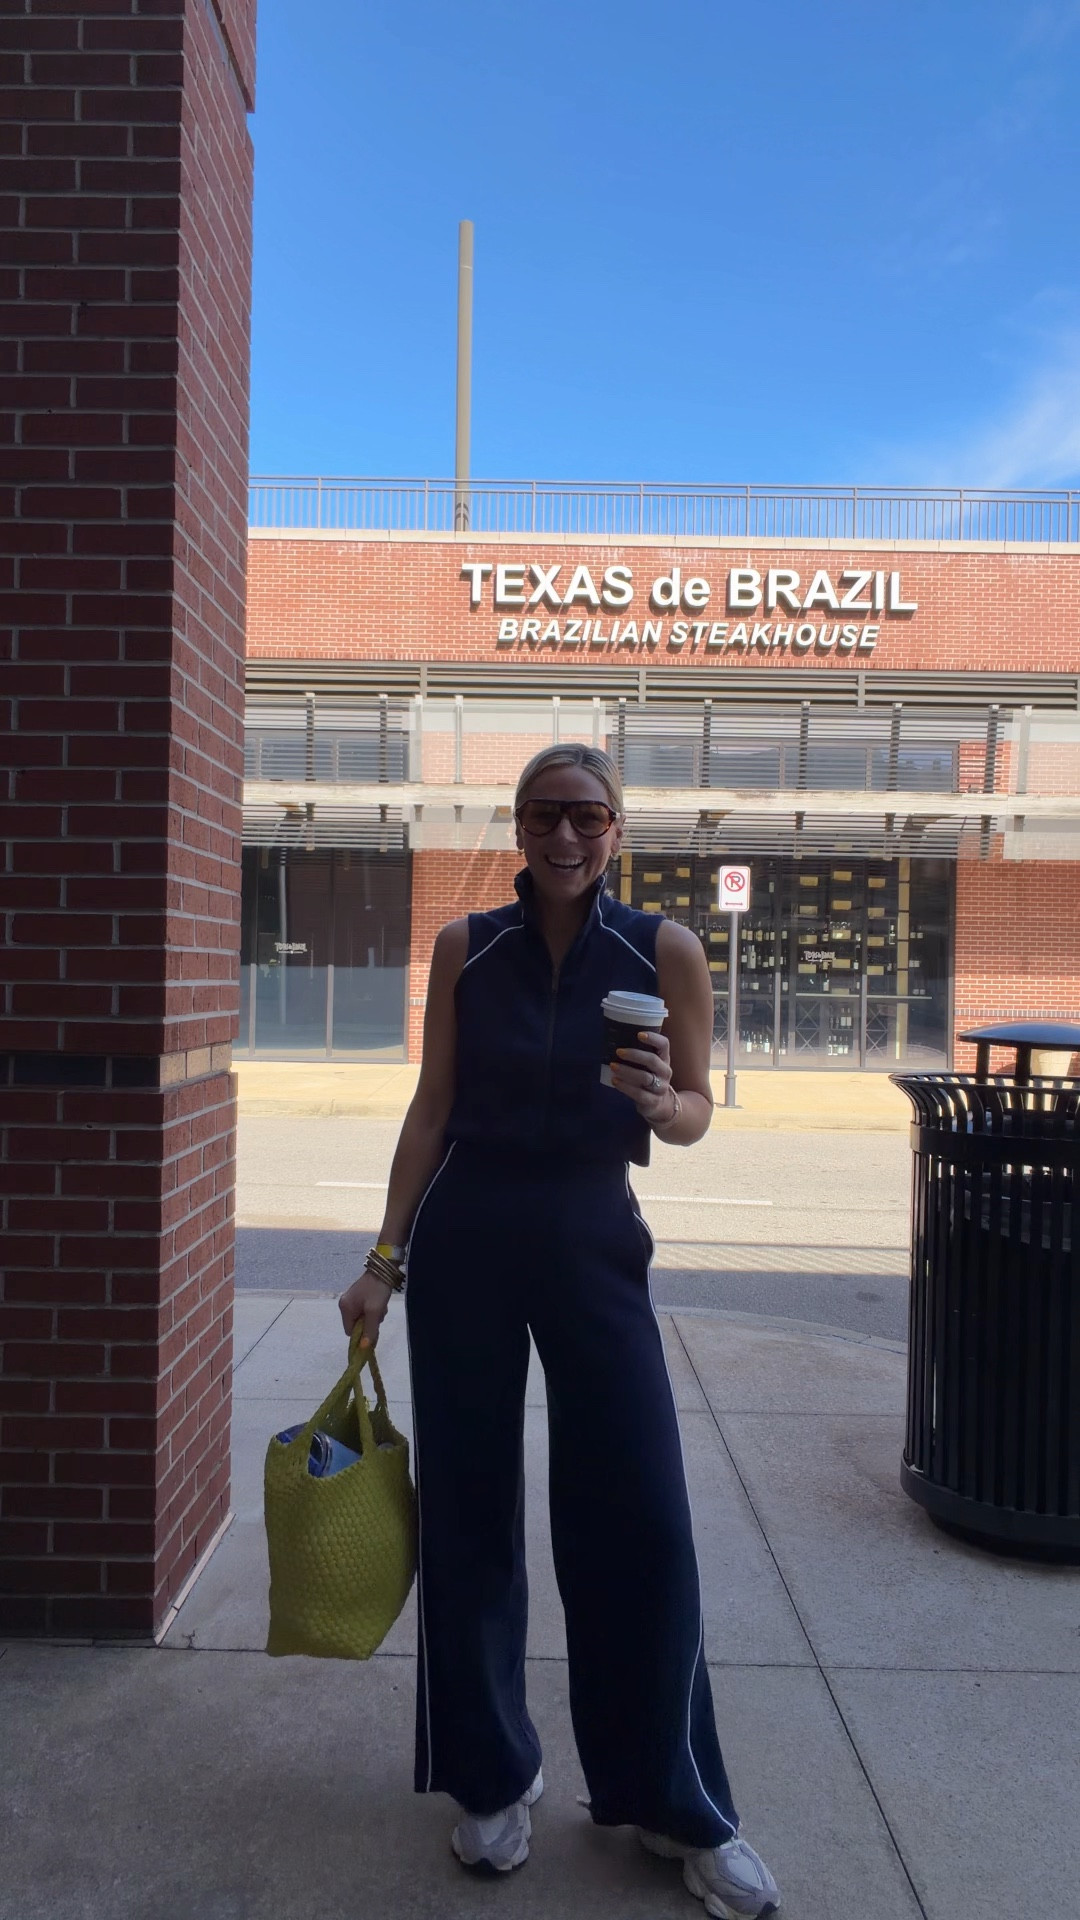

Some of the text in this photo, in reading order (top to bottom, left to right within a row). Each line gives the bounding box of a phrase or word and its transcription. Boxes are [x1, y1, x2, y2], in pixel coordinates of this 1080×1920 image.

[462, 563, 918, 612] TEXAS de BRAZIL
[498, 618, 880, 648] BRAZILIAN STEAKHOUSE
